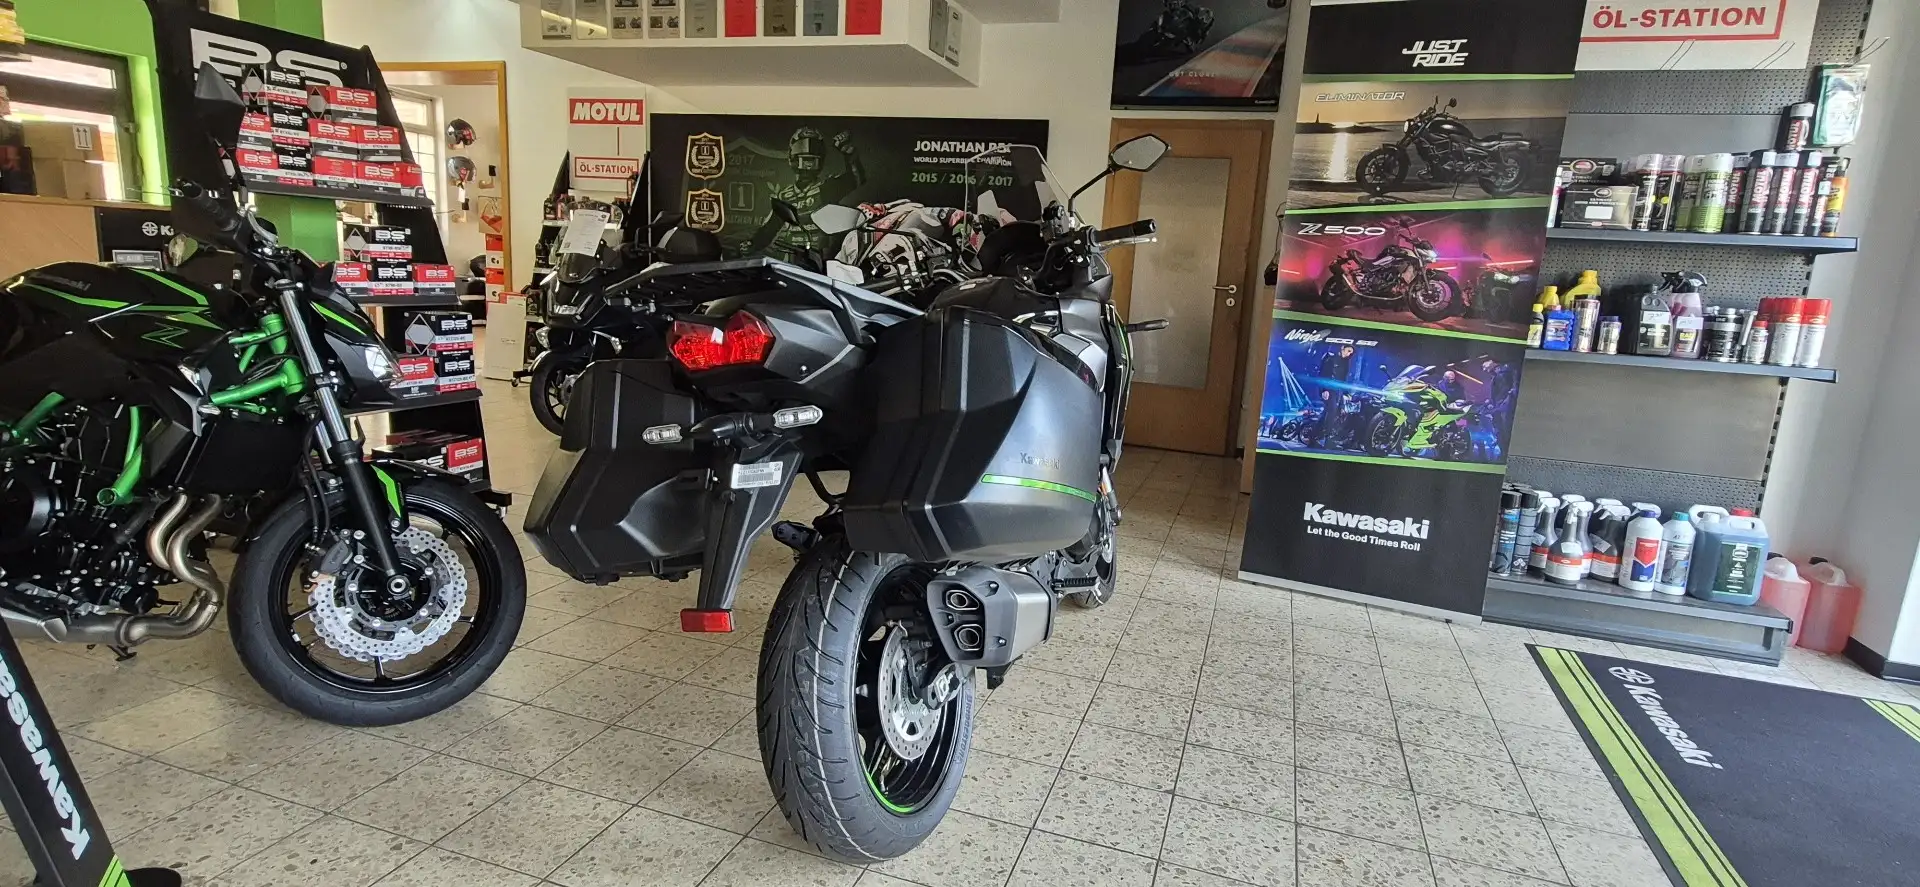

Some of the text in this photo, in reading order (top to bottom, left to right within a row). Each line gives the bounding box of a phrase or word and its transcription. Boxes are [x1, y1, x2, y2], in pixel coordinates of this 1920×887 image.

[1593, 6, 1766, 28] ÖL-STATION
[1402, 39, 1468, 54] JUST
[1412, 53, 1469, 67] RIDE
[270, 71, 300, 81] BS
[337, 90, 369, 102] BS
[1315, 92, 1405, 102] ELIMINATOR
[573, 102, 640, 121] MOTUL
[273, 113, 302, 124] BS
[318, 123, 349, 135] BS
[364, 130, 393, 139] BS
[914, 141, 985, 153] JONATHAN
[244, 154, 272, 164] BS
[279, 155, 307, 165] BS
[365, 166, 393, 177] BS
[579, 161, 634, 174] ÖL-STATION
[912, 173, 937, 182] 2015
[949, 174, 976, 185] 2016
[988, 175, 1013, 186] 2017
[1728, 170, 1741, 203] MOTUL
[1752, 170, 1768, 205] MOTUL
[376, 230, 405, 239] BS
[378, 268, 407, 276] BS
[426, 269, 448, 277] BS
[441, 319, 468, 329] BS
[1284, 329, 1324, 344] Ninja
[400, 363, 428, 372] BS
[445, 360, 471, 370] BS
[454, 446, 478, 456] BS
[1020, 452, 1060, 470] Kawasaki
[1303, 501, 1431, 539] Kawasaki
[1307, 526, 1421, 551] Let the Good Times Roll
[1622, 683, 1724, 770] Kawasaki
[0, 654, 91, 860] Kawasa
